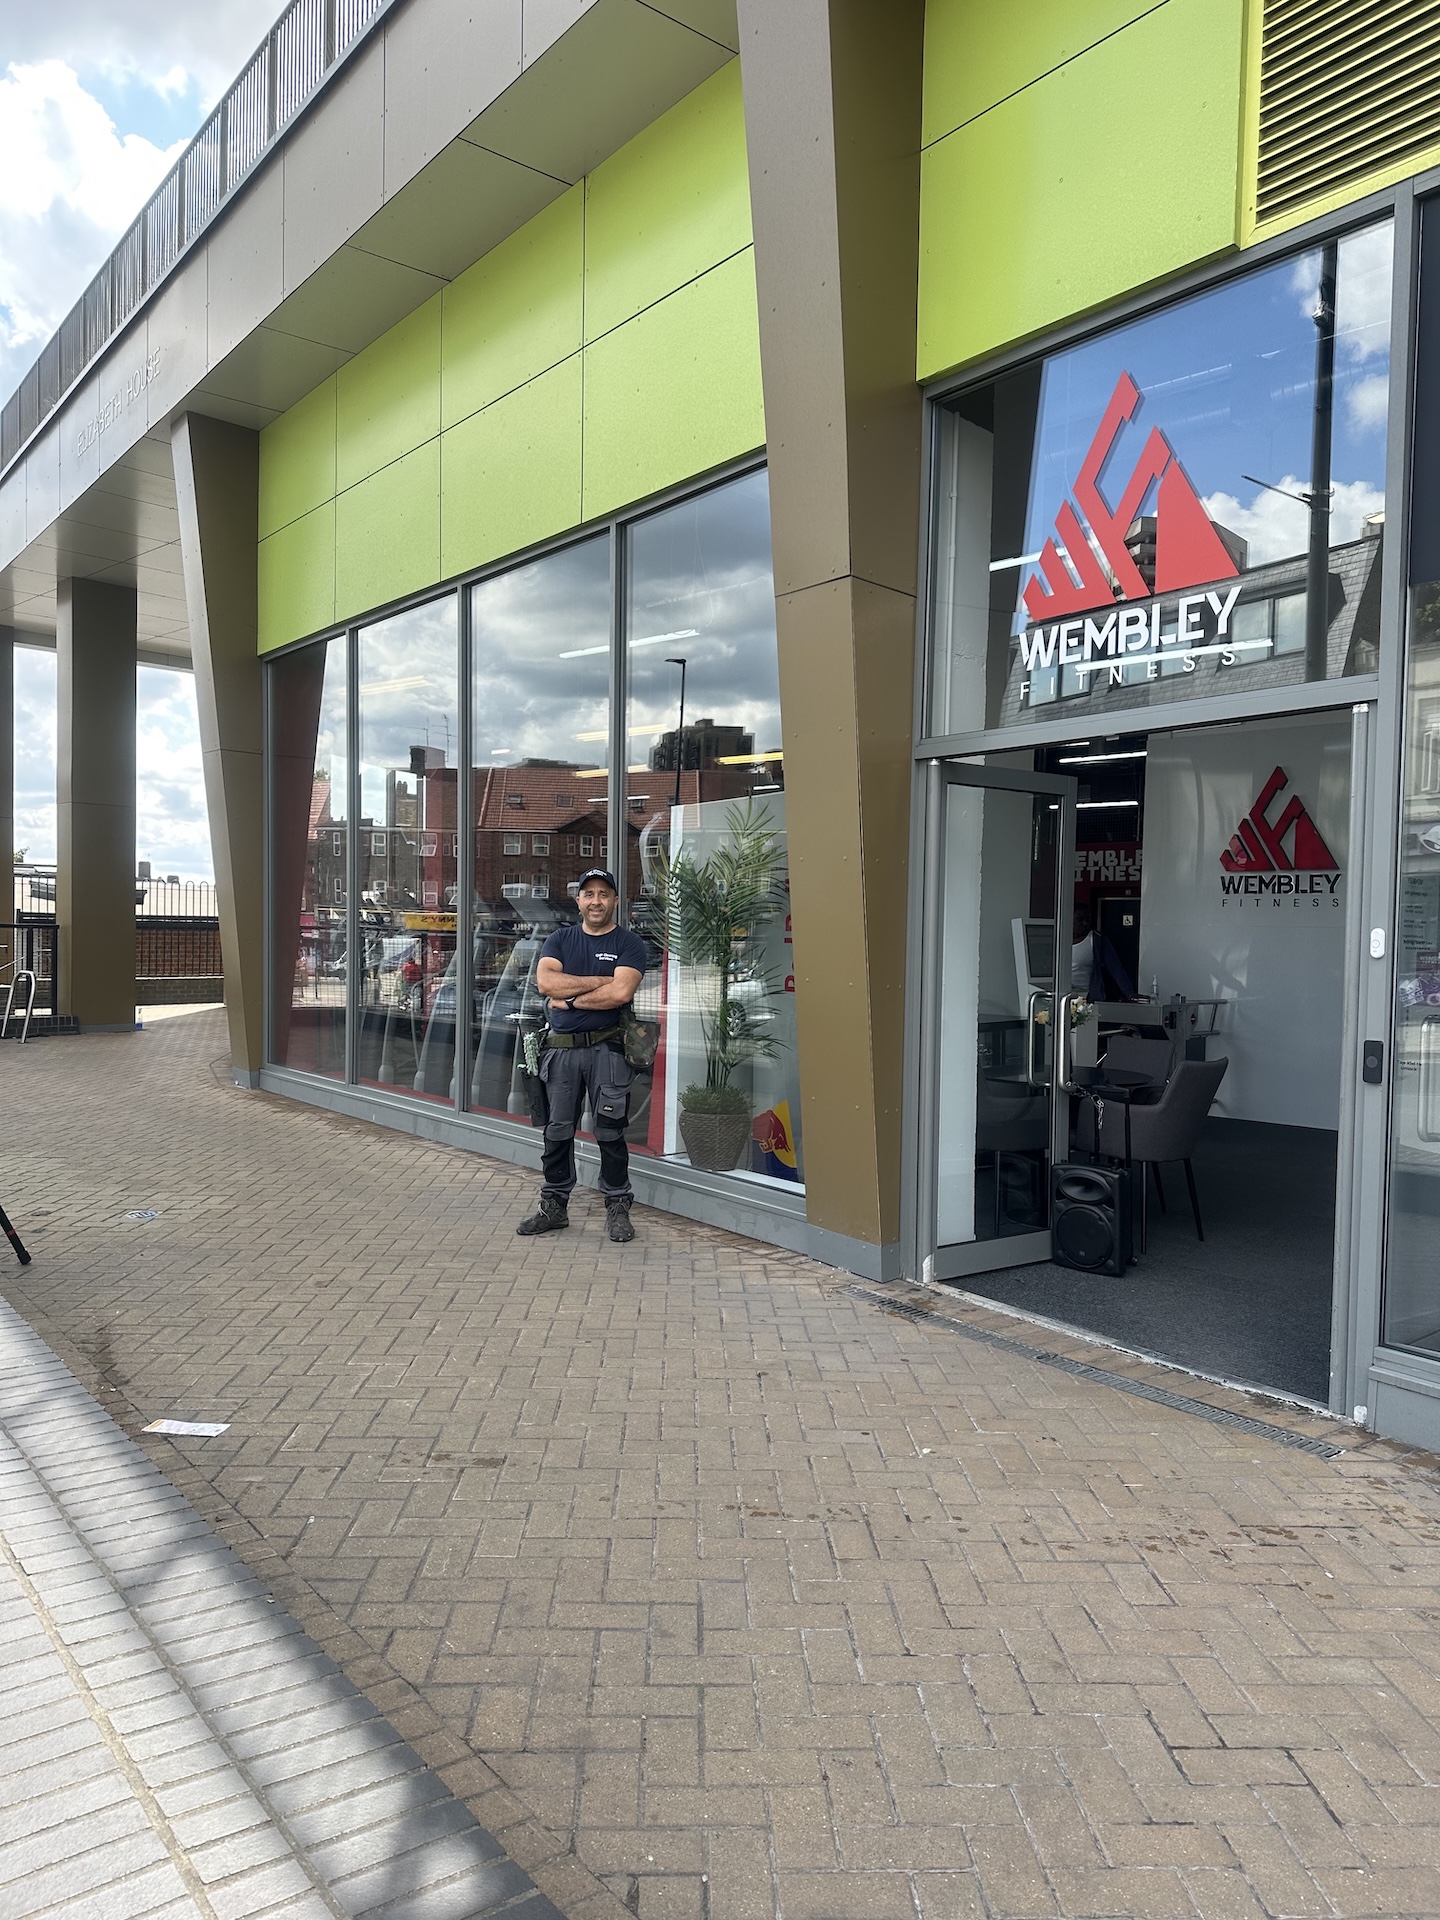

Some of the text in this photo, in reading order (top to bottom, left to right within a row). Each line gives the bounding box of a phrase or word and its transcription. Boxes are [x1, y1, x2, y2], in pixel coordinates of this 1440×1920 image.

[126, 346, 161, 406] HOUSE
[1019, 585, 1242, 671] WEMBLEY
[1019, 646, 1236, 700] FITNESS
[1075, 849, 1143, 867] EMBLE
[1075, 865, 1141, 882] ITNES
[1220, 874, 1341, 894] WEMBLEY
[1222, 898, 1339, 907] FITNESS
